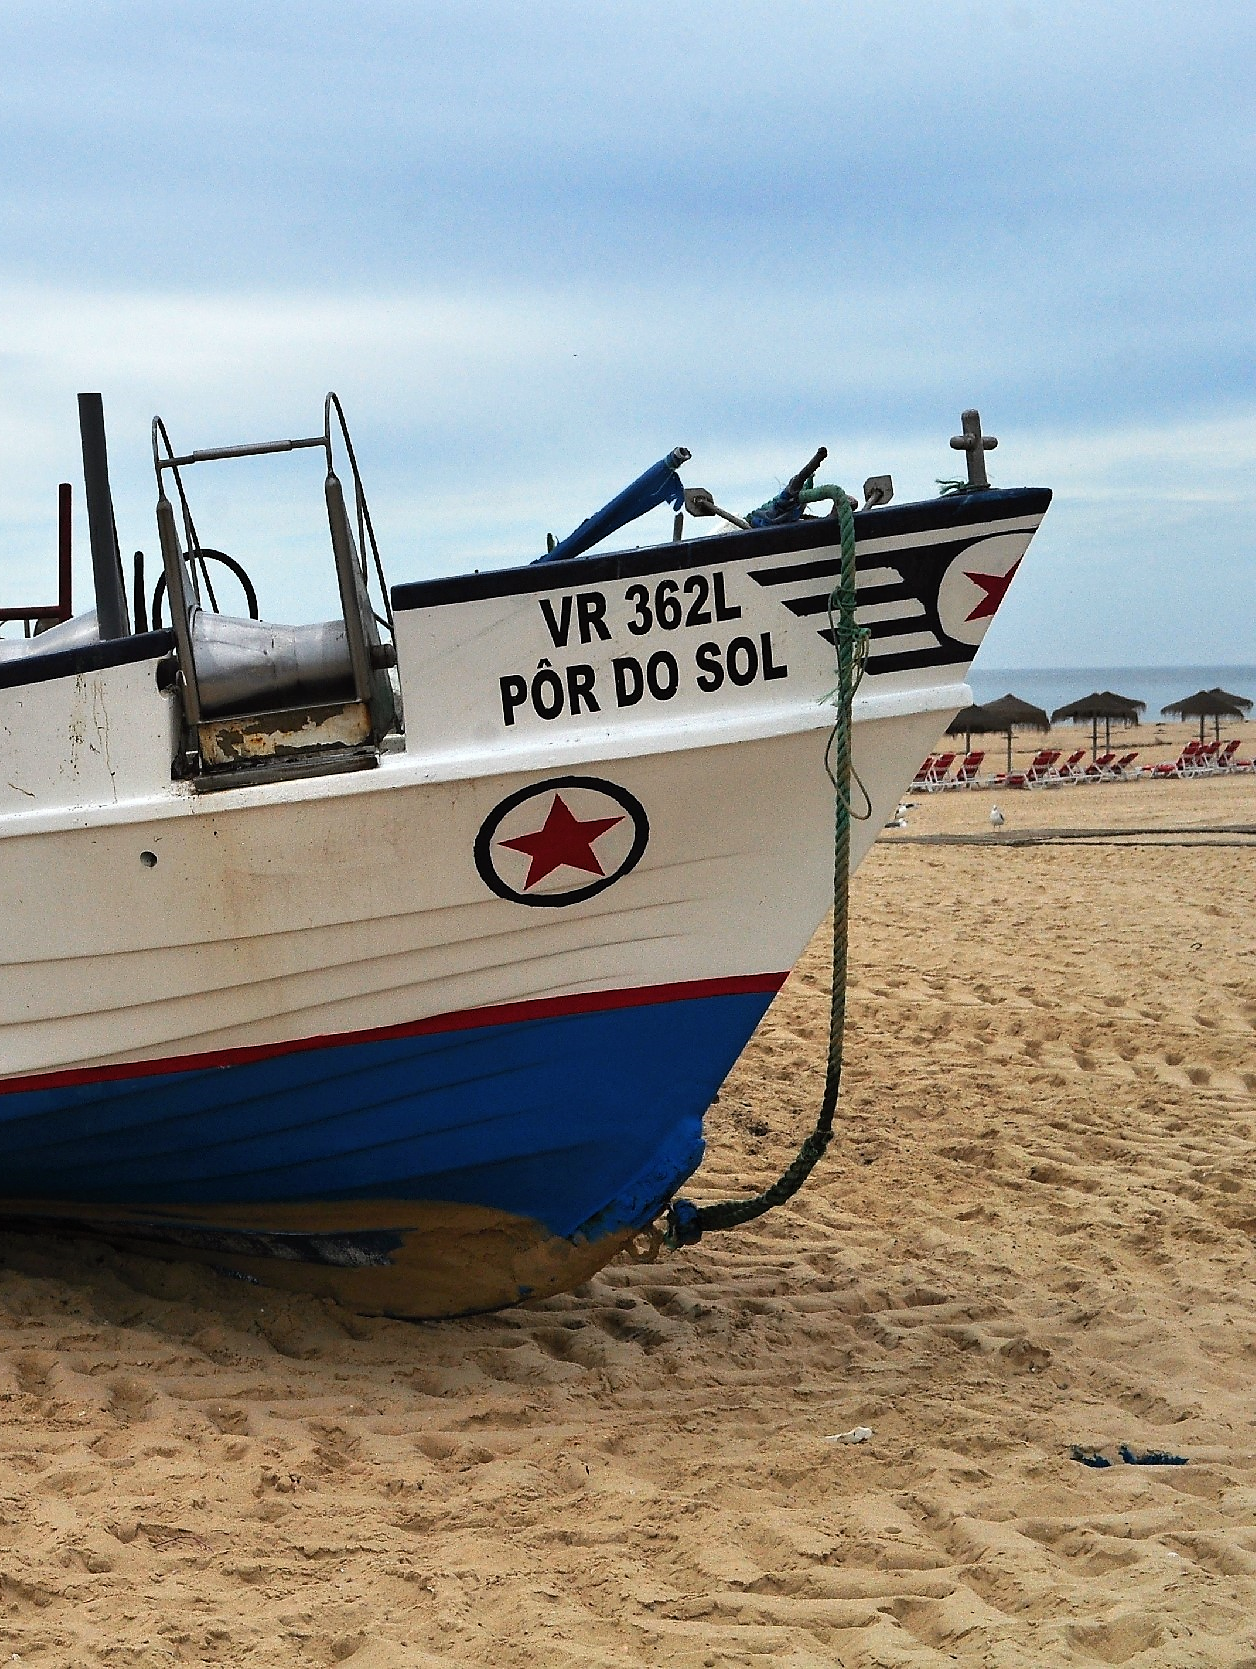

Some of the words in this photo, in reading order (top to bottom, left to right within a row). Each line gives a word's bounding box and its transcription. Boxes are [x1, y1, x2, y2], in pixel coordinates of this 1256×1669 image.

[539, 591, 612, 648] VR
[624, 571, 742, 636] 362L
[499, 658, 601, 727] PÔR
[611, 650, 680, 708] DO
[695, 631, 789, 693] SOL
